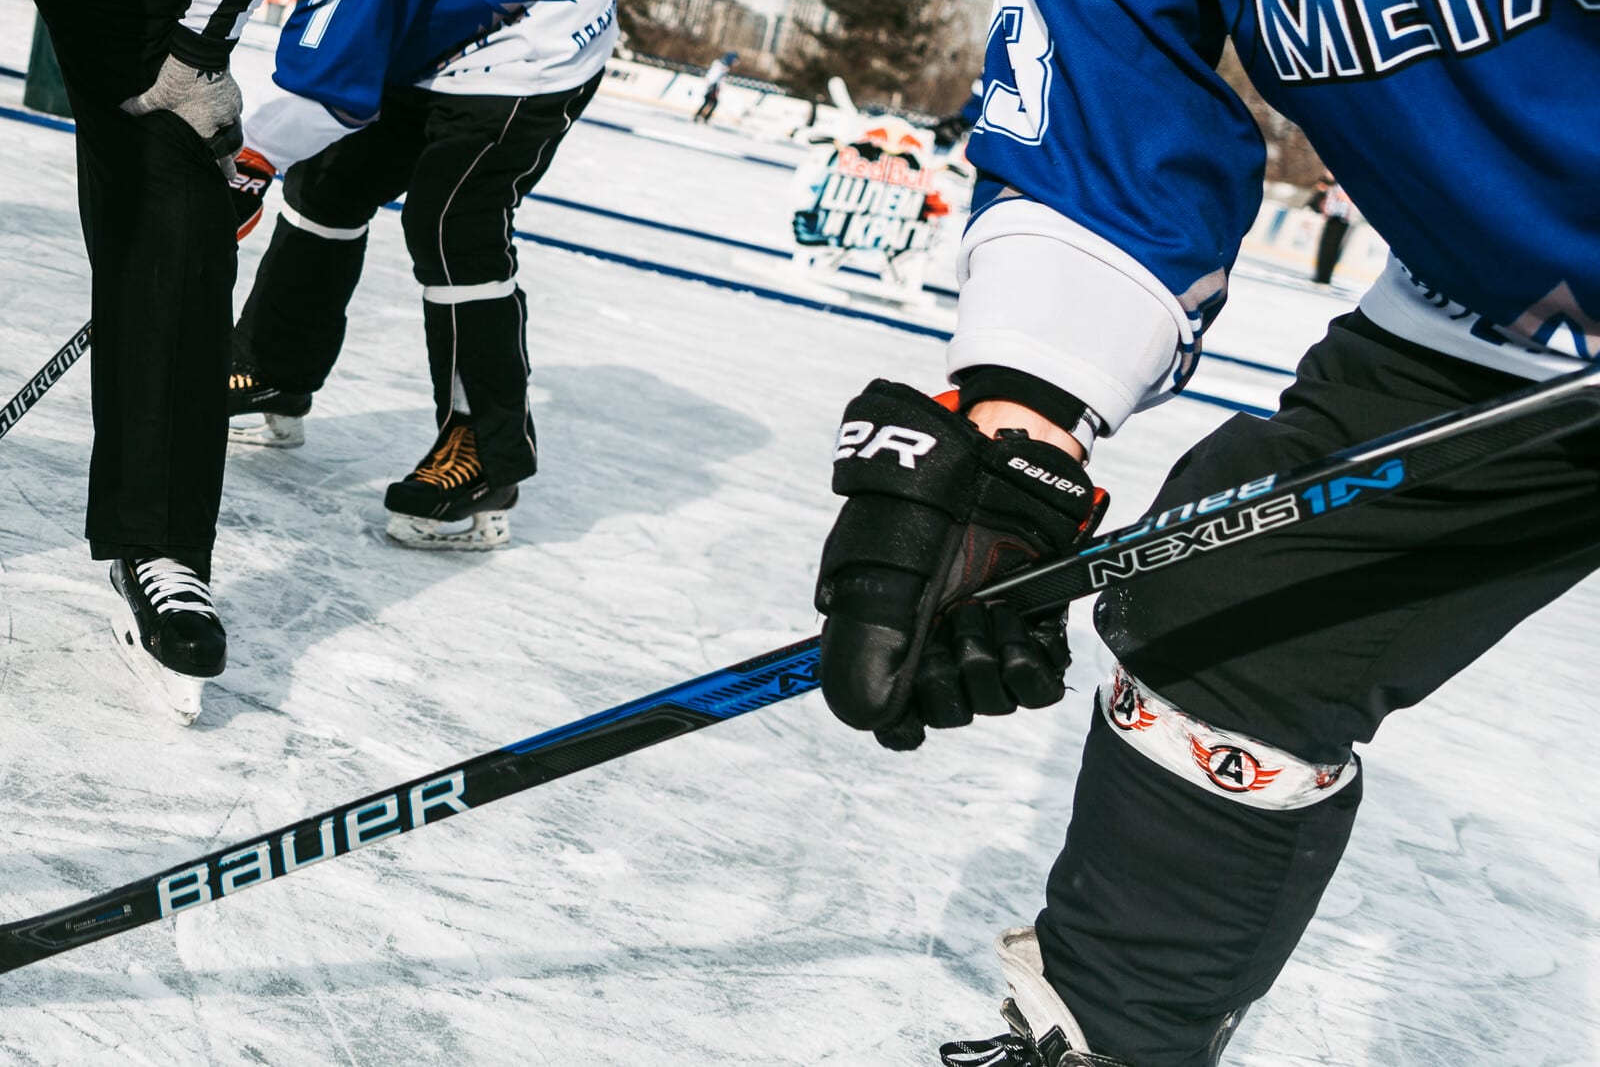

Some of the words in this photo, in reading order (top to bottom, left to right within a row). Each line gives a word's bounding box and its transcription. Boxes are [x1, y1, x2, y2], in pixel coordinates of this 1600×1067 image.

[839, 146, 887, 181] Red
[818, 173, 926, 221] ШЛЕМ
[1006, 456, 1087, 498] BAUER
[1088, 493, 1300, 589] NEXUS
[157, 769, 471, 919] BAUER
